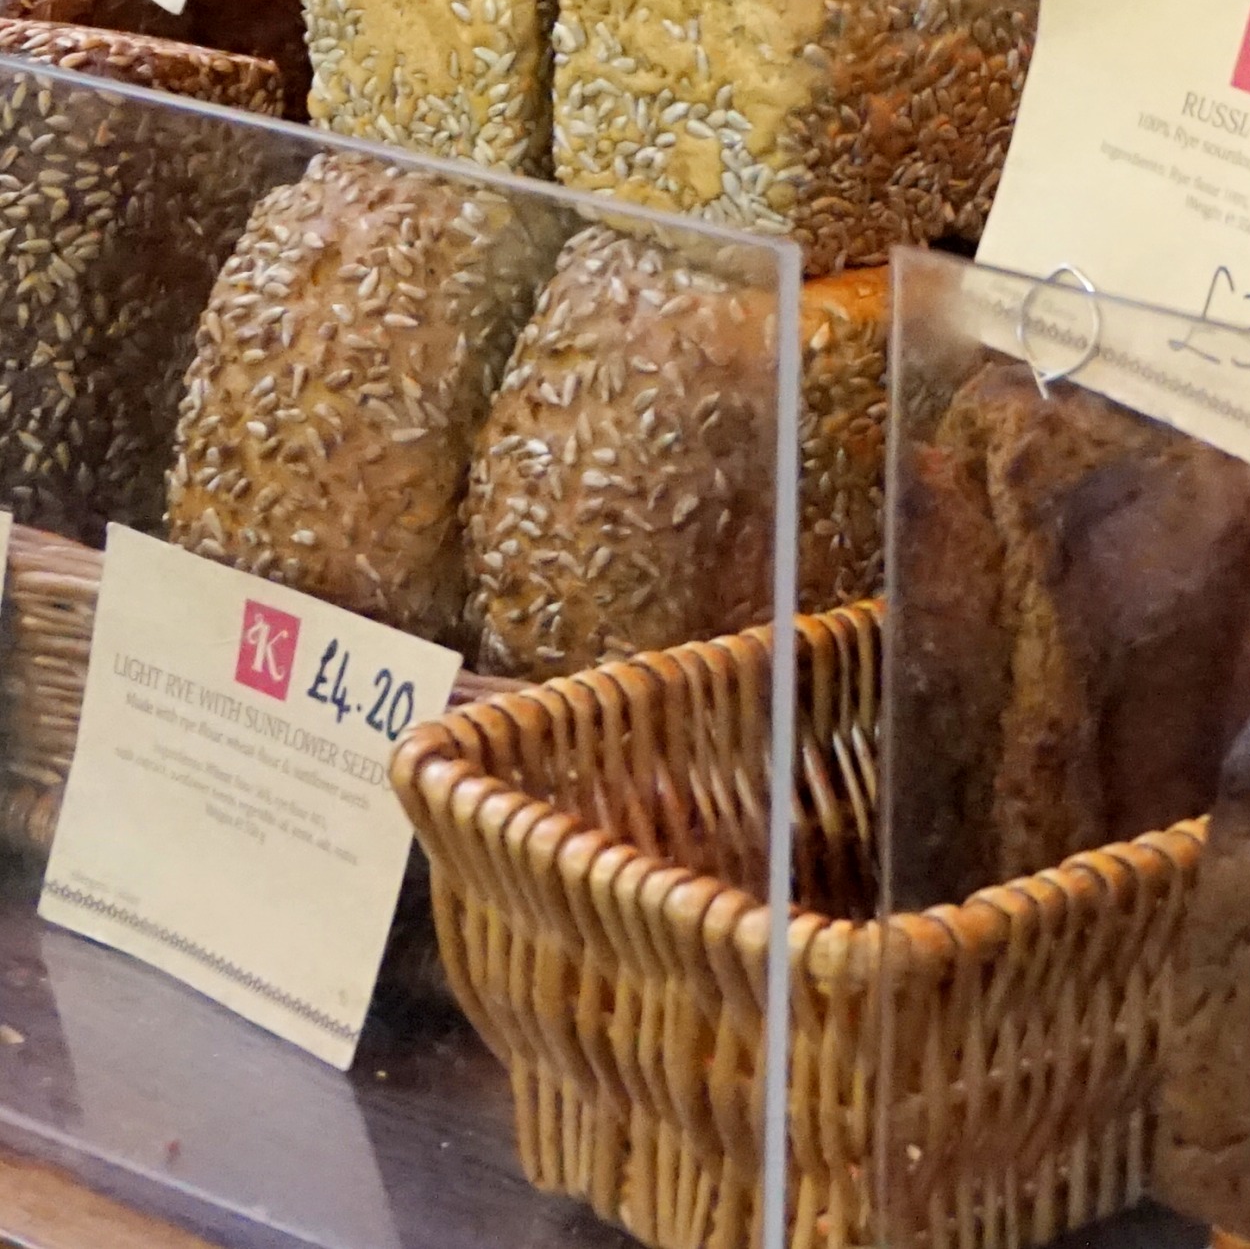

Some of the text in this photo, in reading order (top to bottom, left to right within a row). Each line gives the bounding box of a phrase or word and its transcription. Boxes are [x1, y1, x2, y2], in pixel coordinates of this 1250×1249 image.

[245, 612, 290, 682] K
[305, 638, 416, 741] £4.20
[113, 652, 163, 691] LIGHT
[164, 672, 196, 705] RYE
[197, 686, 243, 724] WITH
[243, 704, 340, 767] SUNFLOWER
